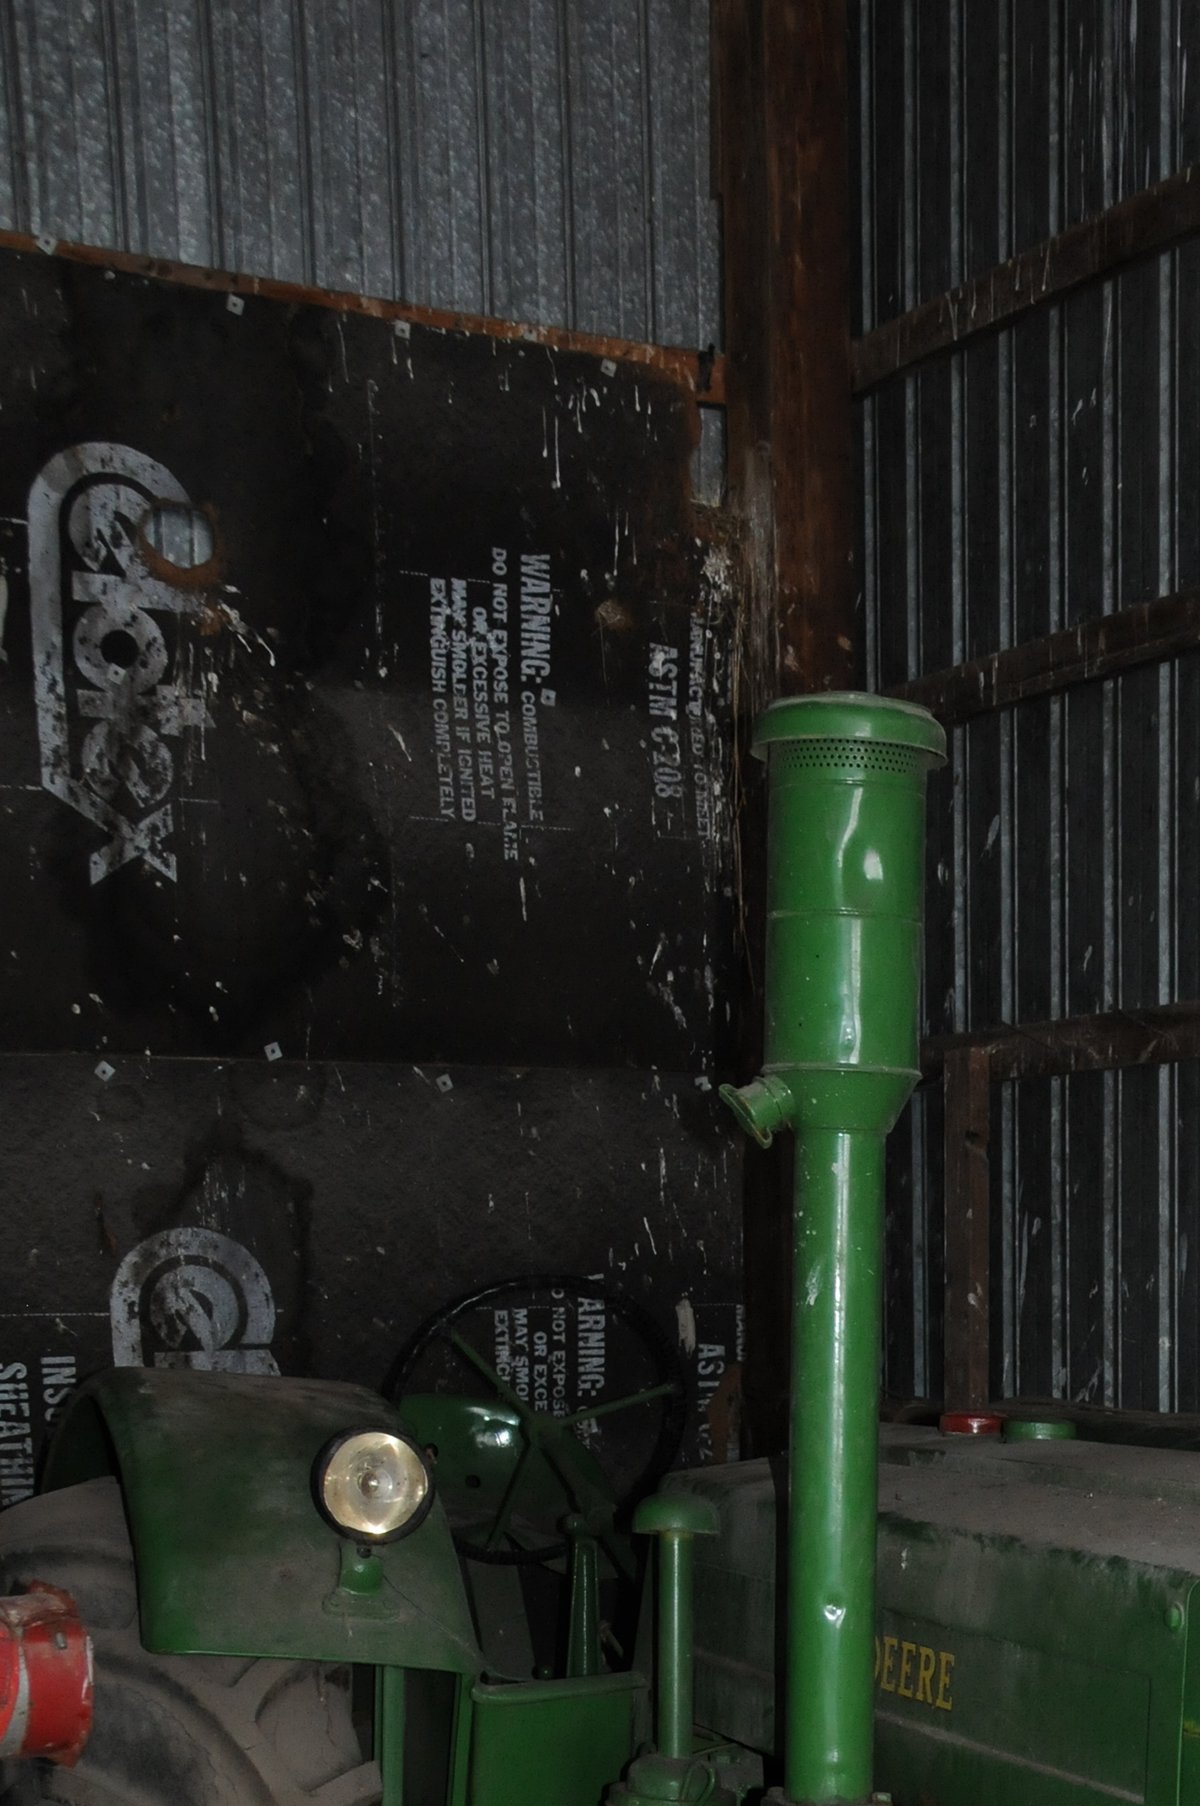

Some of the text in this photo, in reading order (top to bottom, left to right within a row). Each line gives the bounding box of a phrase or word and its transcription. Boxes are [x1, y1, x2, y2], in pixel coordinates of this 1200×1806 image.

[492, 548, 507, 576] DO
[493, 583, 507, 624] NOT
[430, 578, 454, 818] EXTINGUISH COMPLETELY
[451, 578, 475, 821] MAY SMOLDER IF IGNITED
[494, 630, 510, 703] EXPOSE
[520, 554, 551, 821] WARNING: COMBUSTIBLE
[648, 643, 679, 720] ASTM
[472, 607, 494, 799] OR EXCESSIVE HEAT
[496, 711, 510, 734] TO
[498, 742, 514, 789] OPEN
[513, 1308, 529, 1351] MAY
[533, 1331, 547, 1356] OR
[552, 1307, 565, 1343] NOT
[552, 1351, 566, 1417] EXPOSE
[875, 1635, 955, 1711] EERE
